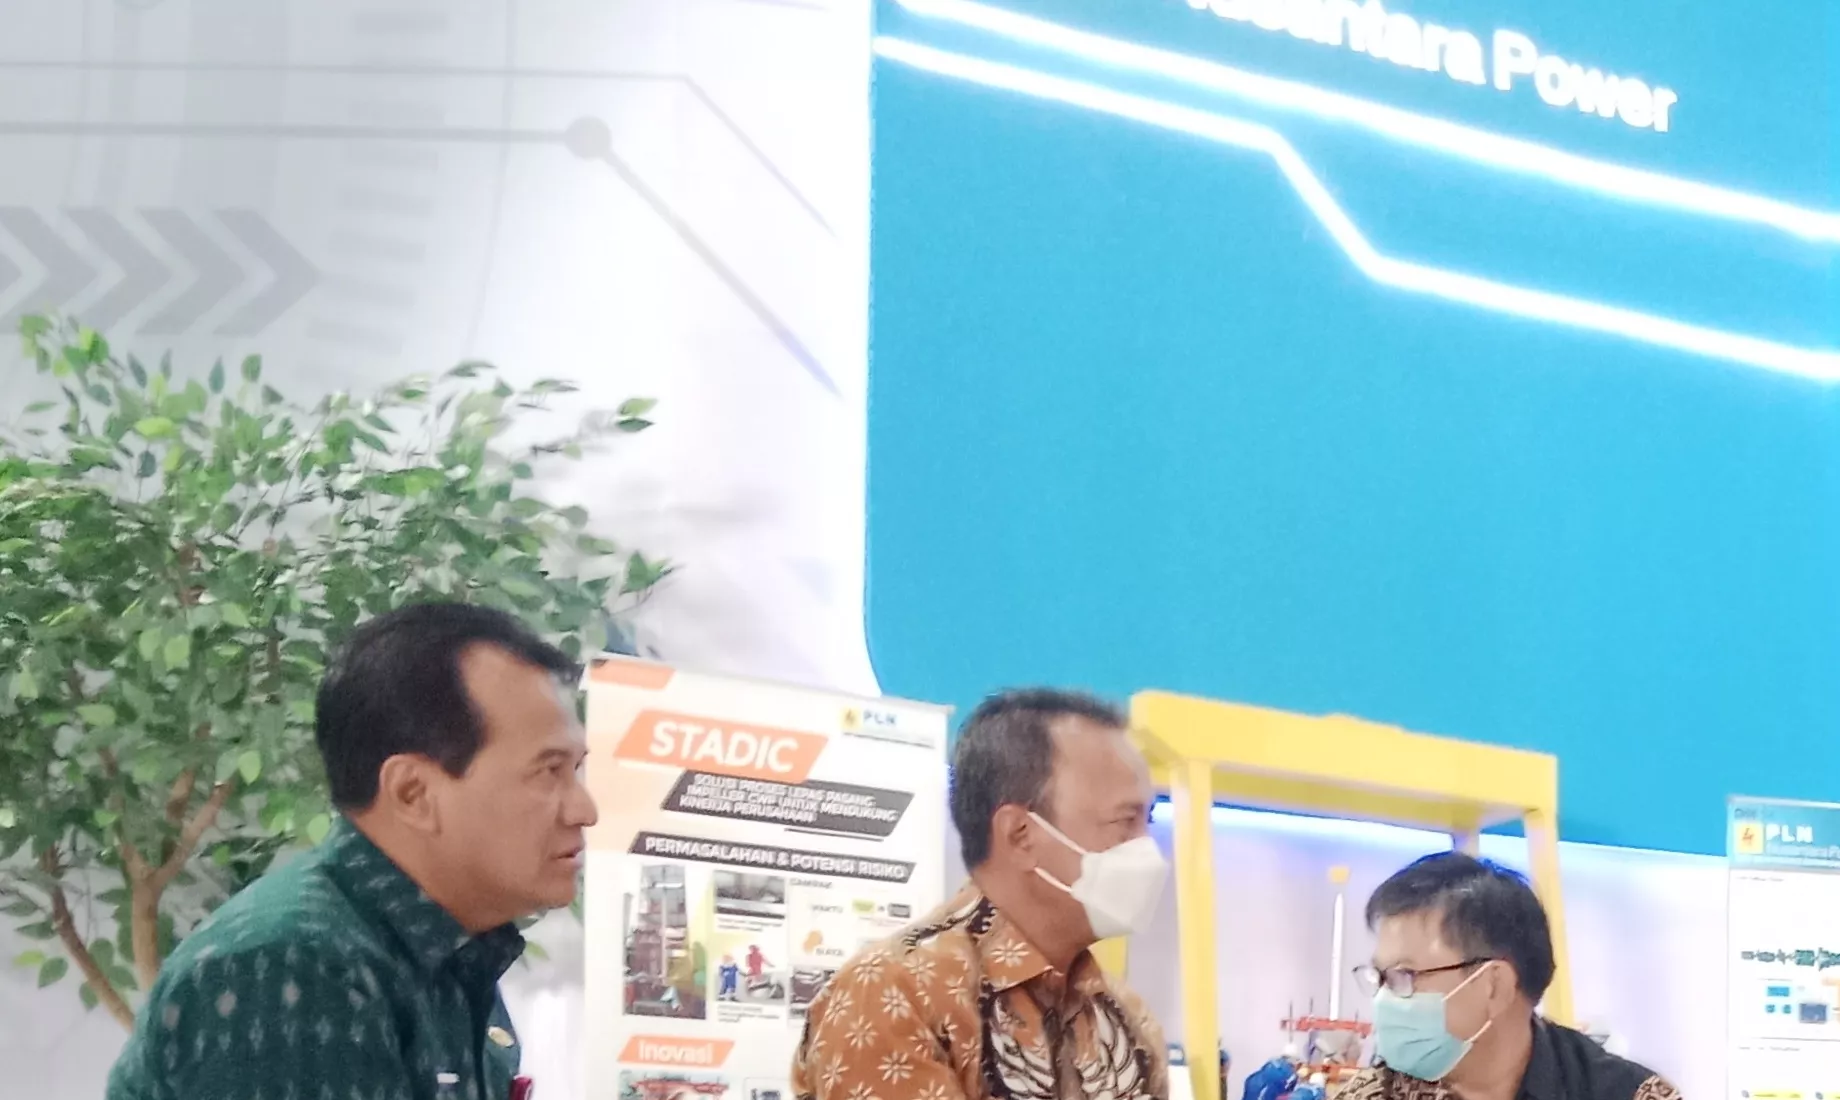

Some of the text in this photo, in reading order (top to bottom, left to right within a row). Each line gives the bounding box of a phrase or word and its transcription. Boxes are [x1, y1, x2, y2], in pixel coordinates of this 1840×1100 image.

[1186, 0, 1678, 133] santara Power
[862, 708, 897, 727] PLN
[649, 720, 798, 773] STADIC
[694, 773, 740, 791] SOLUSI
[740, 779, 787, 796] PROSES
[788, 785, 825, 801] LEPAS
[679, 795, 818, 823] KINERJA PERUSAHAAN
[687, 784, 745, 802] IMPELLER
[778, 796, 818, 812] UNTUK
[820, 801, 900, 823] MENDUKUNG
[1765, 823, 1814, 844] PLN
[645, 836, 909, 879] PERMASALAHAN & POTENSI RISIKO
[638, 1039, 714, 1064] Inovasi
